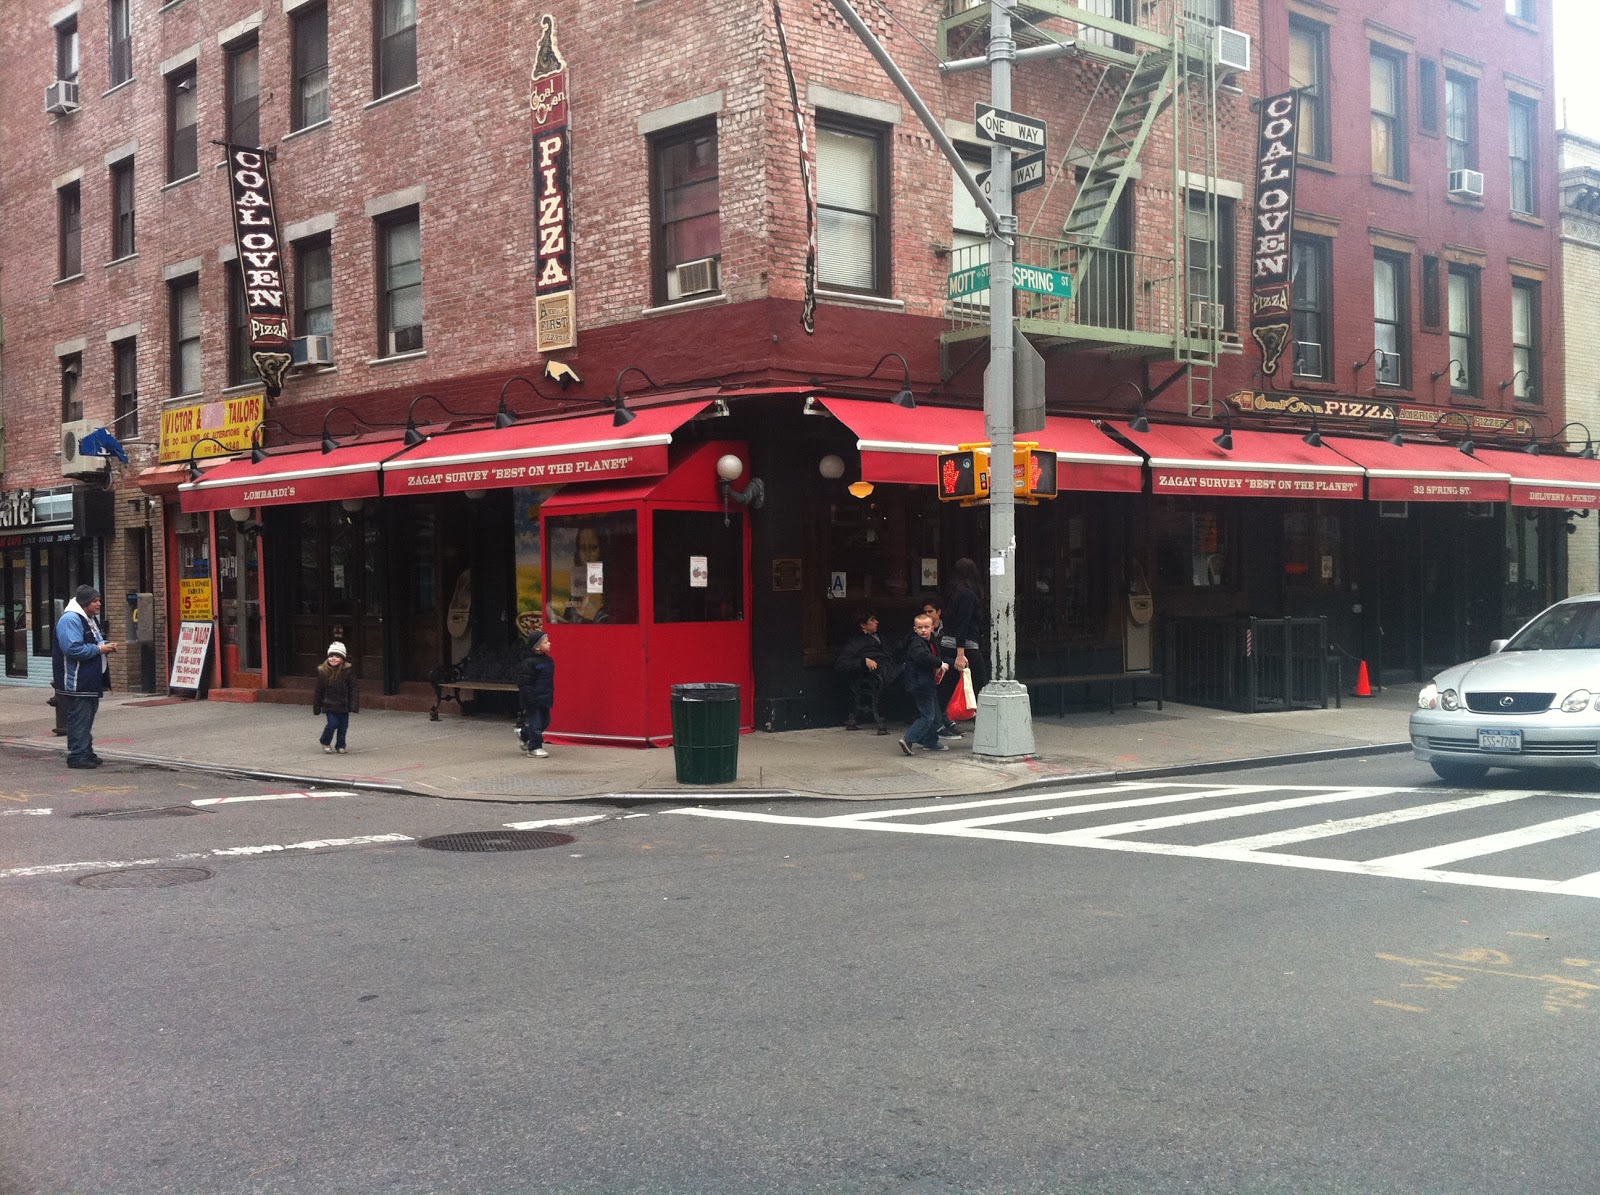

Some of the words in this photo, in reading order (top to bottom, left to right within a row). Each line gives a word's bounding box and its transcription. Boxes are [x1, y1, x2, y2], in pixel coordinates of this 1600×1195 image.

[985, 116, 1006, 134] ONE
[1018, 125, 1039, 142] WAY
[1261, 97, 1292, 183] COAL
[1016, 164, 1037, 183] WAY
[235, 151, 270, 225] COAL
[538, 136, 568, 286] PIZZA
[1255, 189, 1288, 277] OVEN
[242, 233, 283, 307] OVEN
[949, 270, 976, 296] MOTT
[981, 267, 990, 278] ST
[1013, 266, 1054, 293] SPRING
[1061, 276, 1069, 287] ST
[1253, 290, 1288, 316] PIZZA
[251, 318, 288, 341] PIZZA
[540, 316, 568, 332] FIRST
[165, 410, 193, 434] VICTOR
[228, 398, 259, 424] TAILORS
[1325, 401, 1399, 420] PIZZA
[407, 474, 443, 486] ZAGAT
[445, 470, 489, 483] SURVEY
[528, 465, 545, 477] ON
[548, 463, 573, 475] THE
[1159, 475, 1197, 487] ZAGAT
[1199, 477, 1243, 488] SURVEY
[1278, 480, 1292, 490] ON
[1294, 480, 1315, 490] THE
[243, 486, 295, 501] LOMBARDI'S
[1413, 485, 1424, 494] 32
[1426, 486, 1458, 495] SPRING
[0, 491, 30, 527] afé
[833, 575, 843, 591] A
